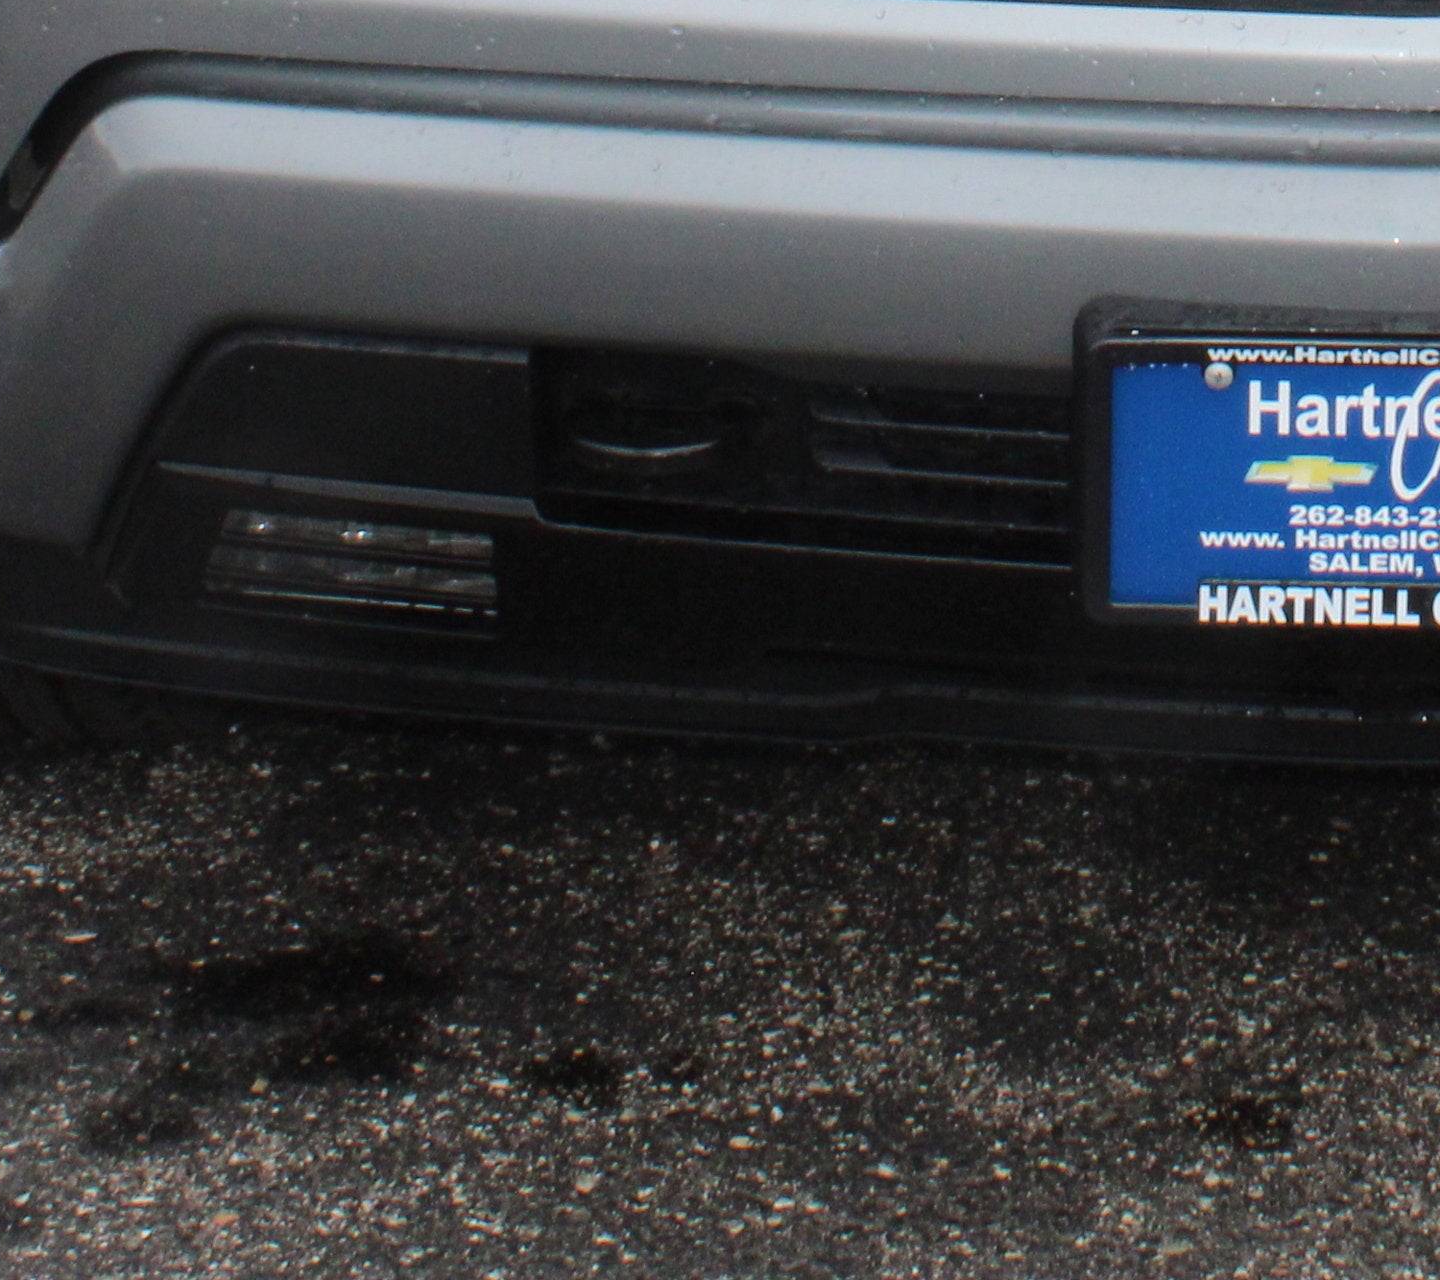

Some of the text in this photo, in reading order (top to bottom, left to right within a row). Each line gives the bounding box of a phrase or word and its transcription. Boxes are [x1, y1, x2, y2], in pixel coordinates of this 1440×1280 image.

[1199, 530, 1286, 549] www.
[1308, 551, 1425, 578] SALEM,
[1198, 584, 1421, 626] HARTNELL
